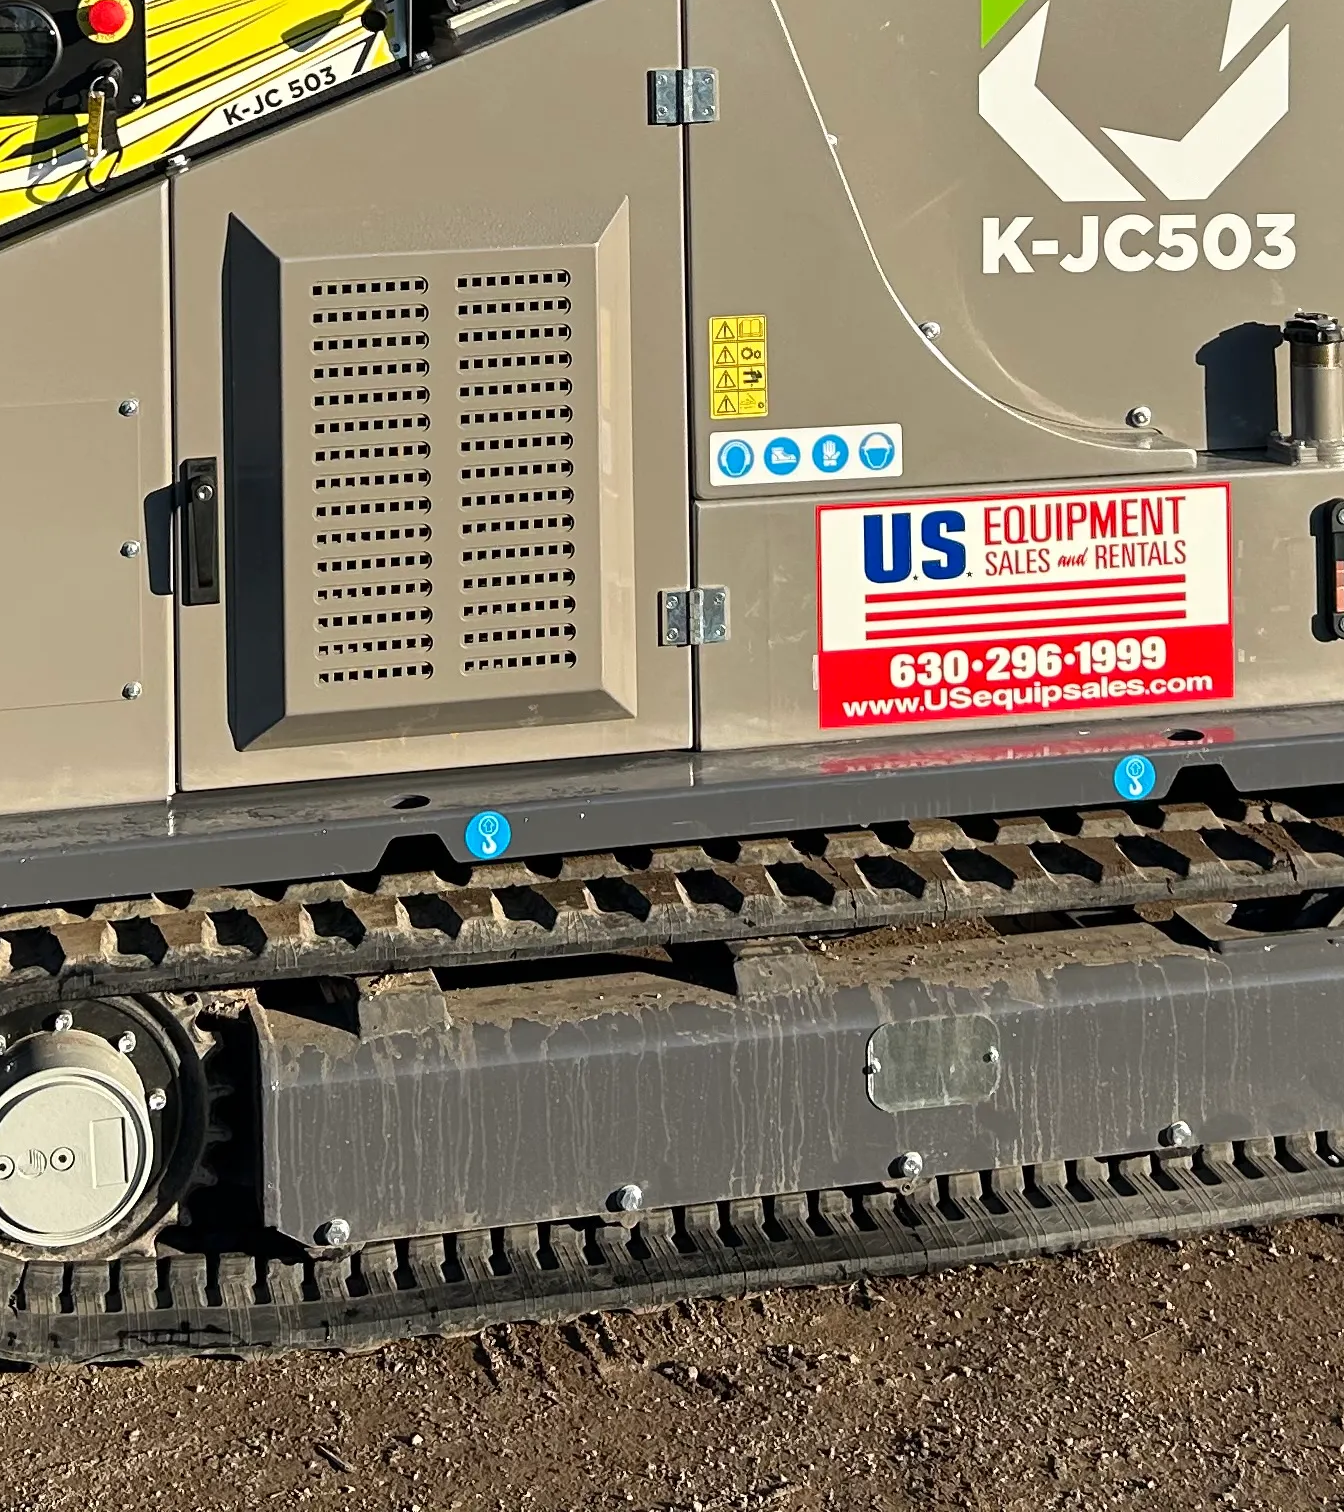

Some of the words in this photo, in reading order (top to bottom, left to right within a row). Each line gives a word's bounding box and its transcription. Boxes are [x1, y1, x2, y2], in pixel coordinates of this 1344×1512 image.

[223, 88, 283, 126] K-JC
[288, 65, 337, 99] 503
[982, 213, 1297, 274] K-JC503
[983, 496, 1186, 546] EQUIPMENT
[985, 548, 1051, 576] SALES
[1057, 548, 1089, 568] and
[1094, 540, 1186, 570] RENTALS
[842, 673, 1213, 718] www.USequipsales.com
